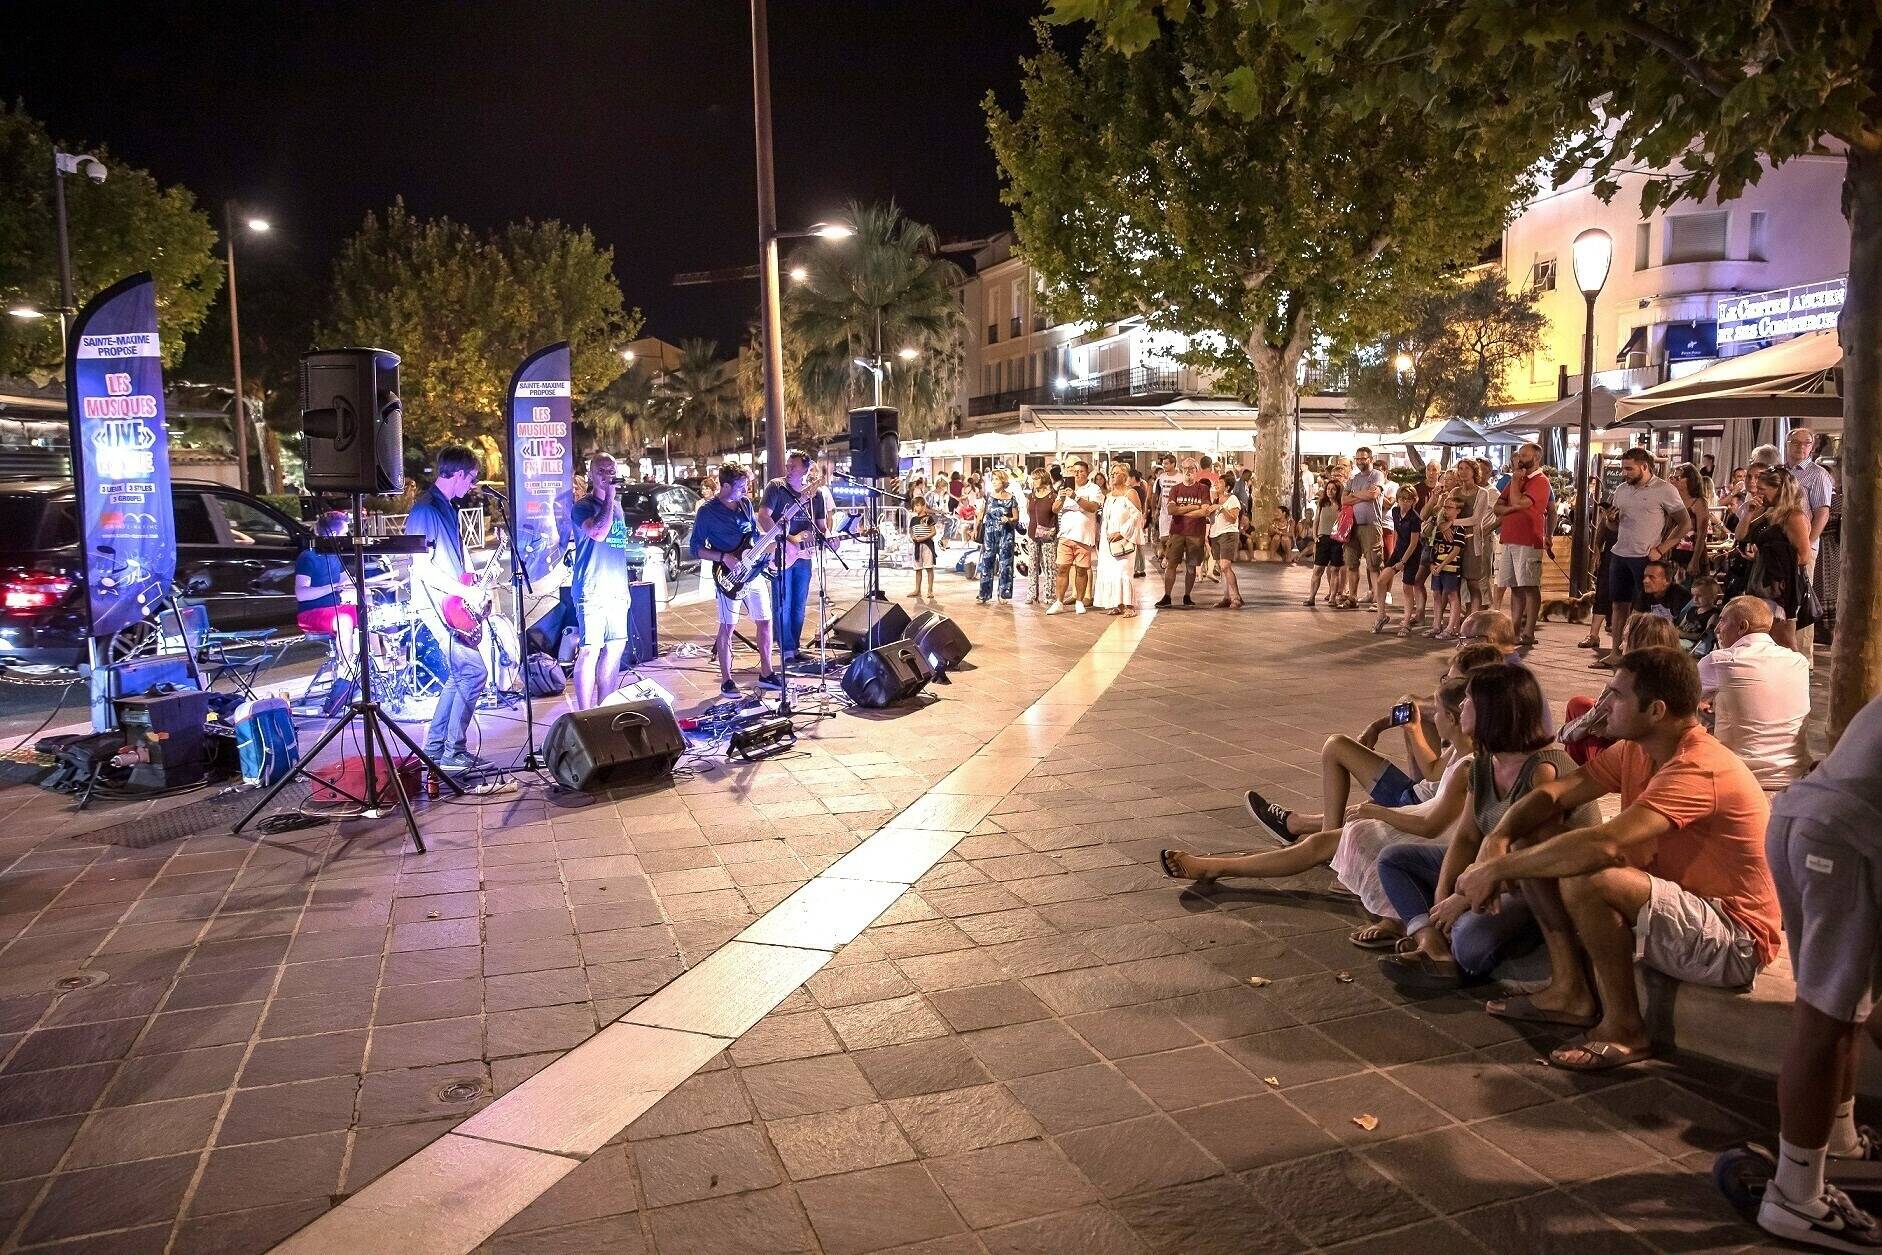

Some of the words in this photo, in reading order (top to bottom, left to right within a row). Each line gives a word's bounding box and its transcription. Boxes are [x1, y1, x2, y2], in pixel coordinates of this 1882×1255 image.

[83, 335, 150, 347] SAINTE-MAXIME
[98, 346, 138, 356] PROPOSE
[108, 375, 130, 393] LES
[86, 397, 156, 417] MUSIQUES
[534, 408, 550, 421] LES
[518, 423, 566, 436] MUSIQUES
